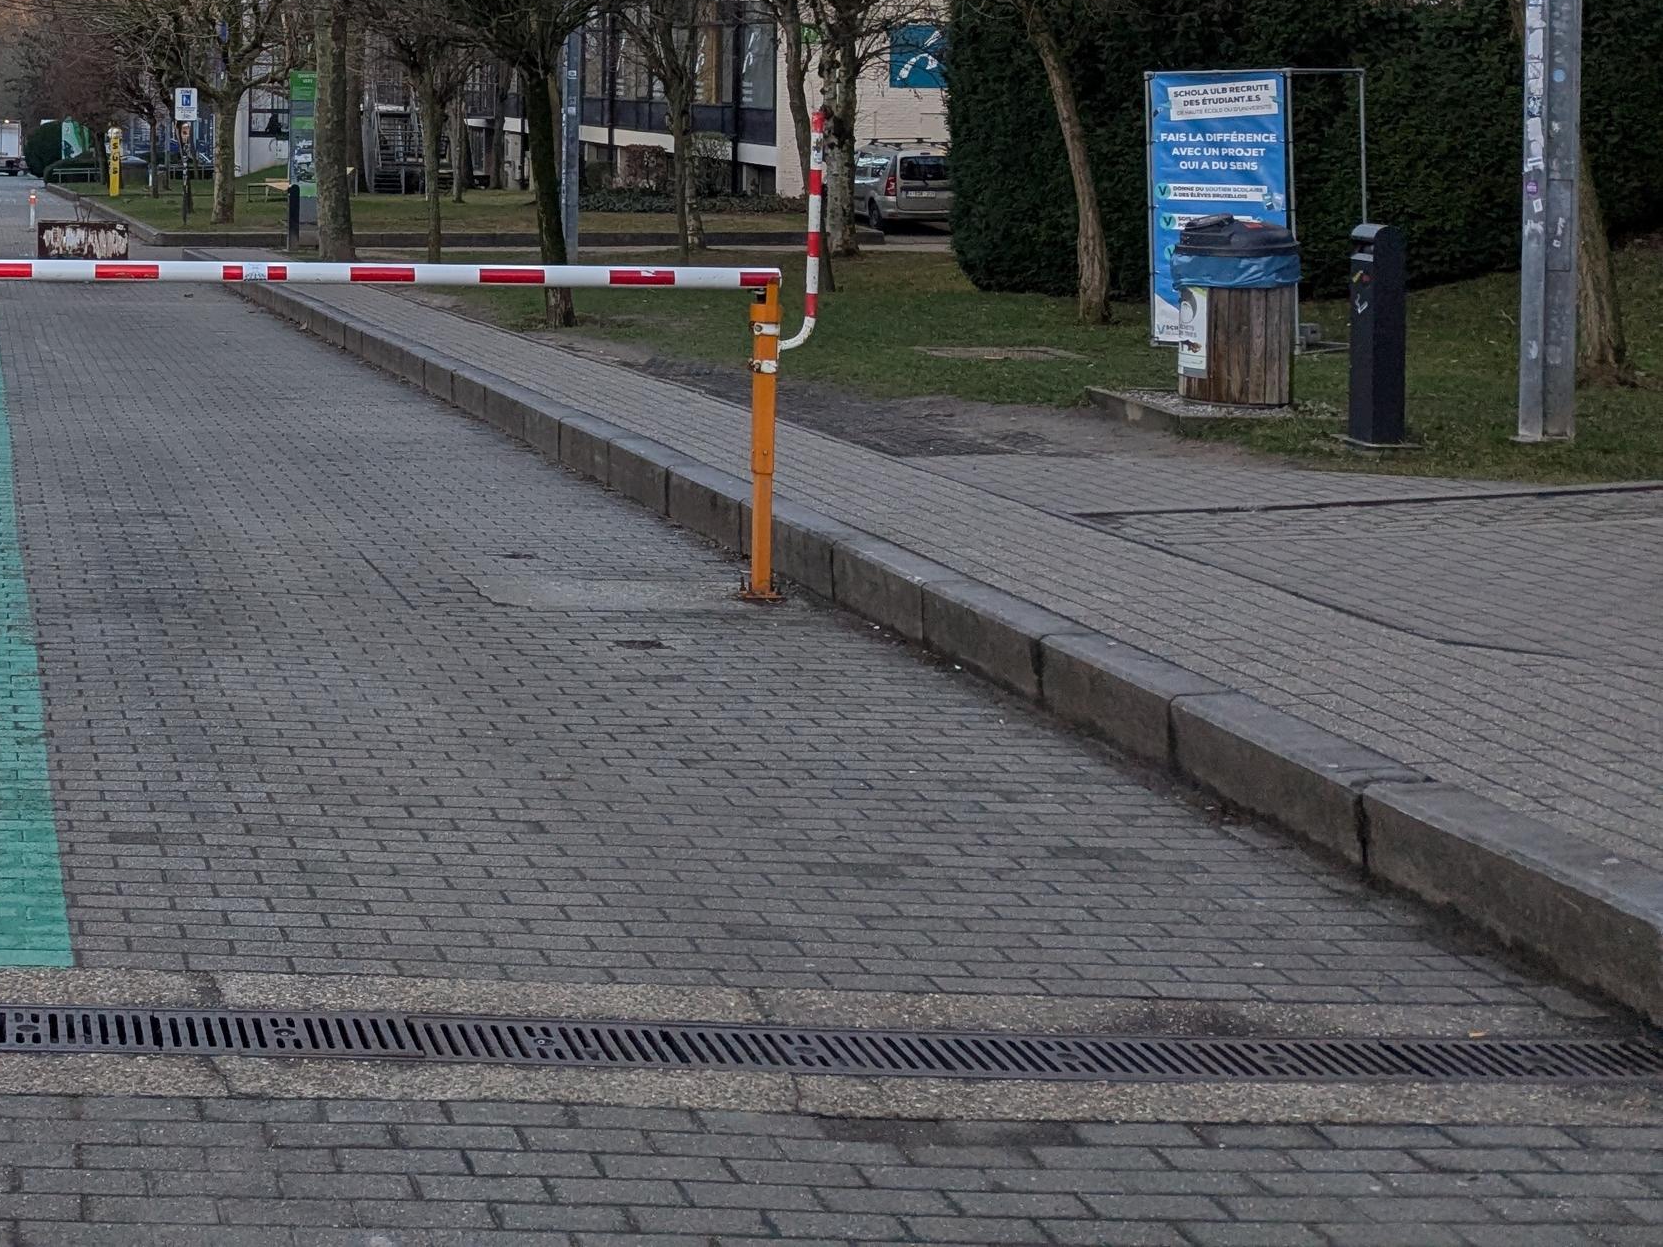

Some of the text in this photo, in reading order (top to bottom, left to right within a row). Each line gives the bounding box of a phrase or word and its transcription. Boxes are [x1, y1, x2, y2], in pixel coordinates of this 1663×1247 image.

[1174, 89, 1209, 97] SCHOLA
[1230, 84, 1269, 93] RECRUTE
[1161, 132, 1277, 142] FAIS LA DIFFÉRENCE
[1172, 147, 1266, 156] AVEC UN PROJET
[1180, 161, 1257, 170] QUI A DU SENS
